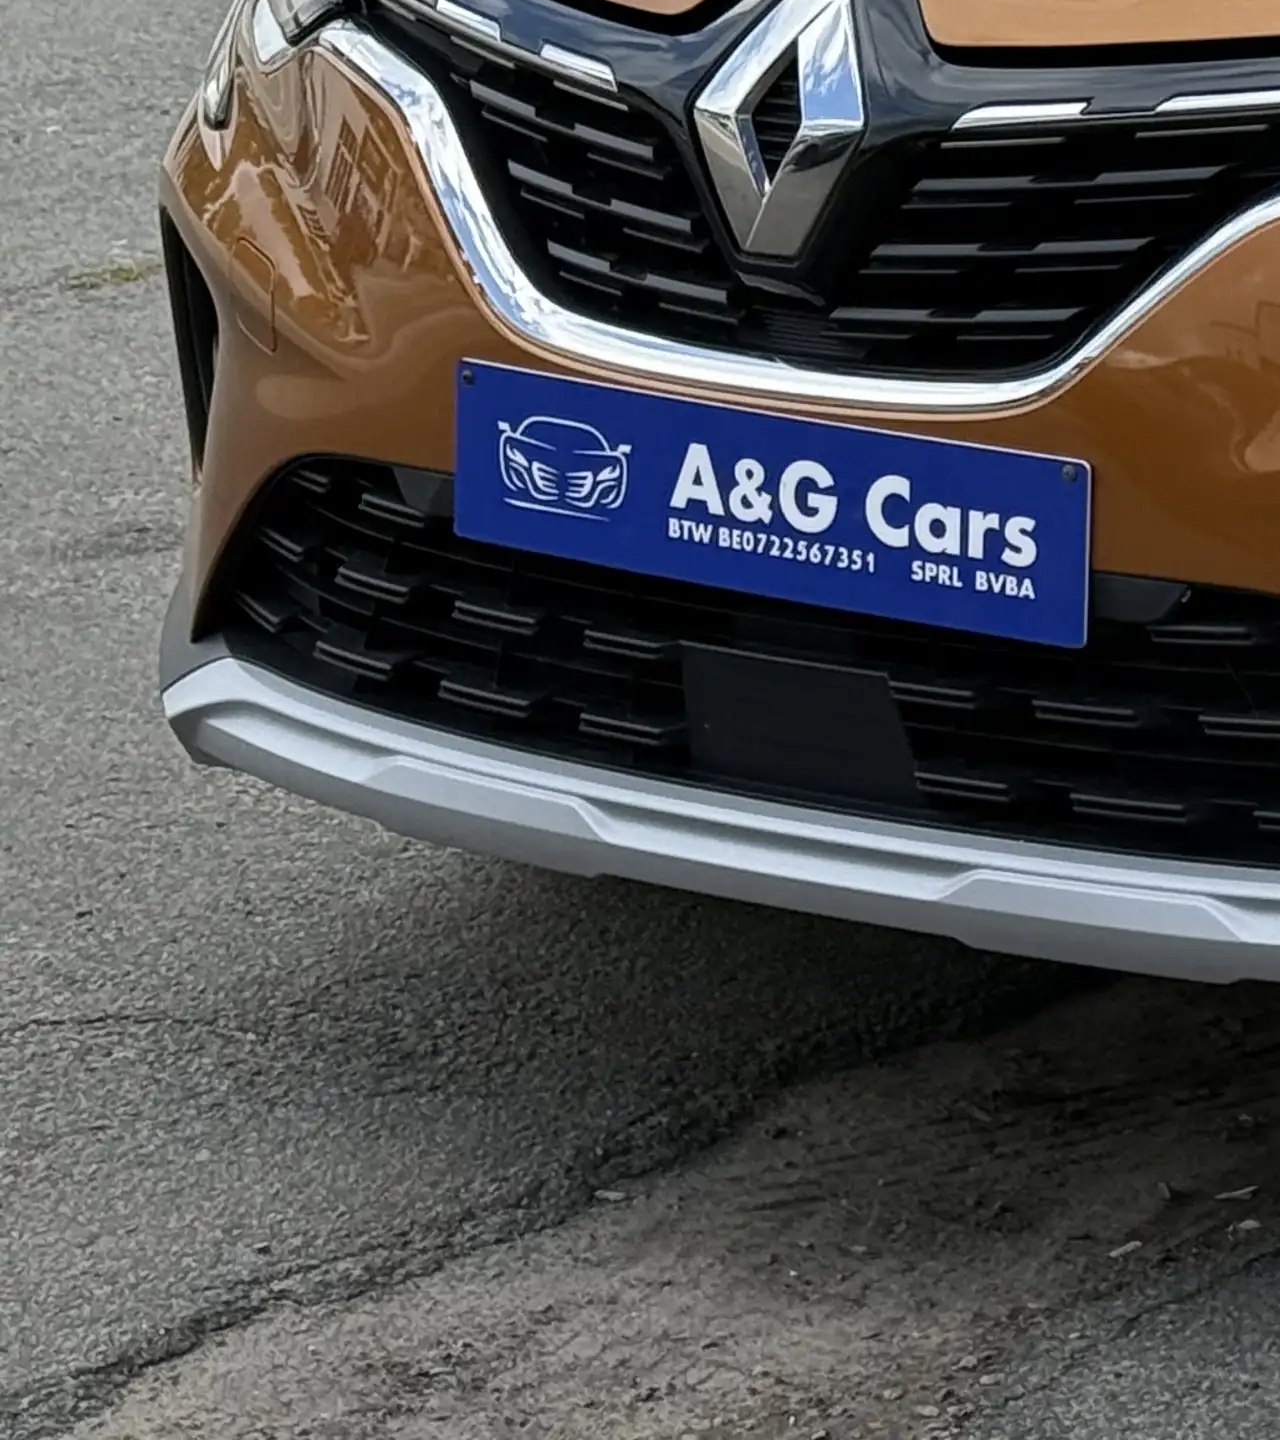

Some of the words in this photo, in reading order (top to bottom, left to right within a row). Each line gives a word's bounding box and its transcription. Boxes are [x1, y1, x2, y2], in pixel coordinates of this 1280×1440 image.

[669, 442, 838, 534] A&G
[865, 474, 1037, 568] Cars
[667, 517, 713, 545] BTW
[718, 525, 875, 573] BE0722567351
[910, 560, 963, 588] SPRL
[974, 570, 1036, 599] BVBA
